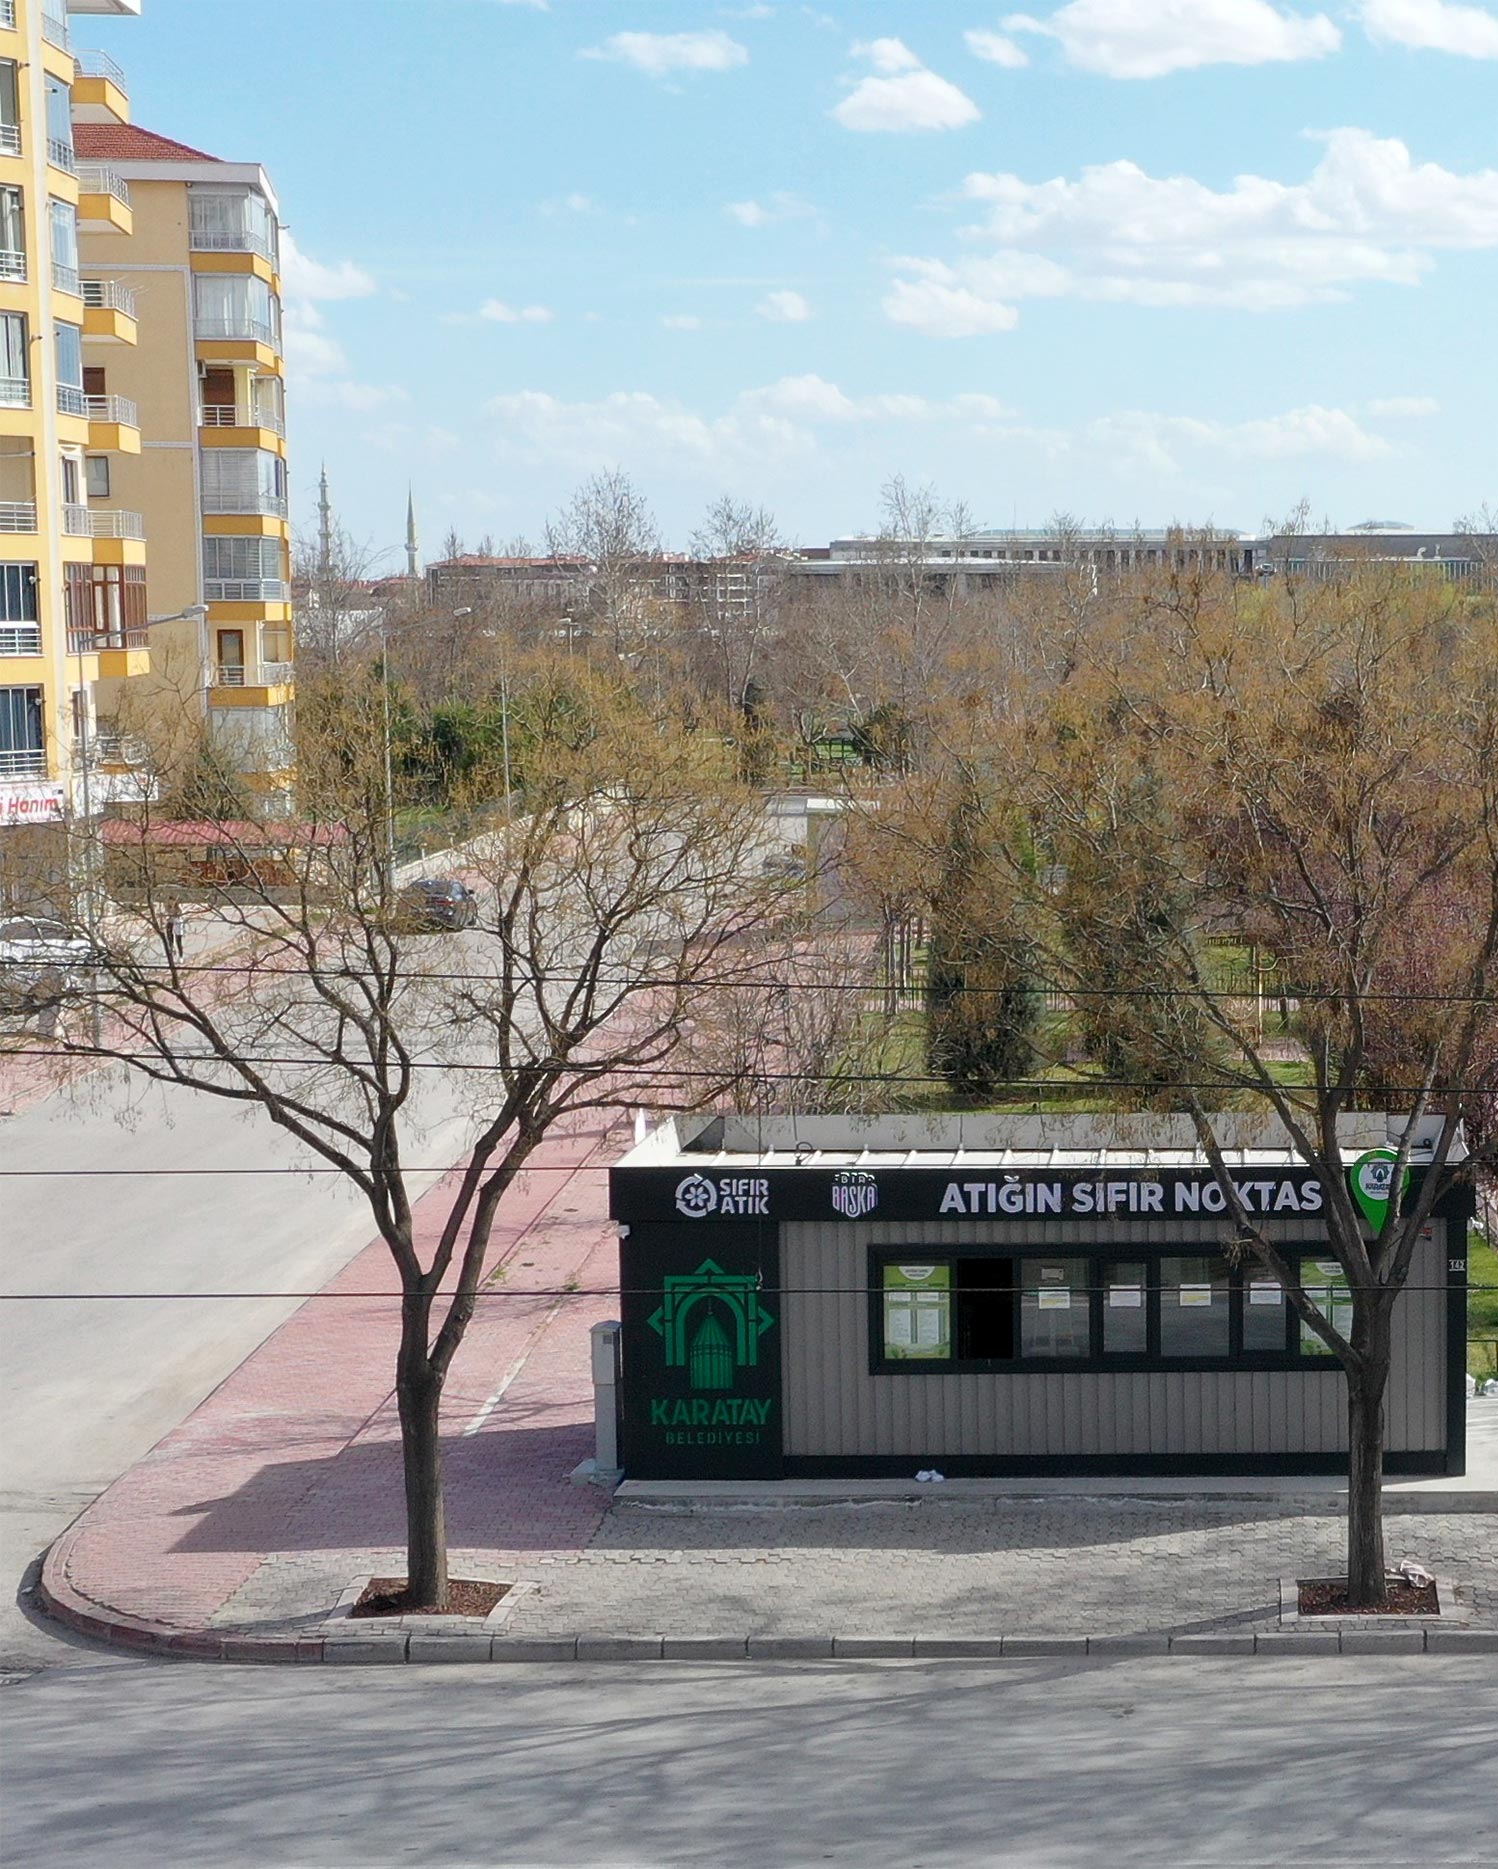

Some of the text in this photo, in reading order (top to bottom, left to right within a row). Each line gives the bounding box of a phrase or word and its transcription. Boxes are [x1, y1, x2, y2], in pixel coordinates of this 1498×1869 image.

[719, 1178, 769, 1196] SIFIR
[938, 1175, 1323, 1213] ATIĞIN SIFIR NOKTAS
[720, 1196, 770, 1215] ATIK
[651, 1398, 772, 1426] KARATAY
